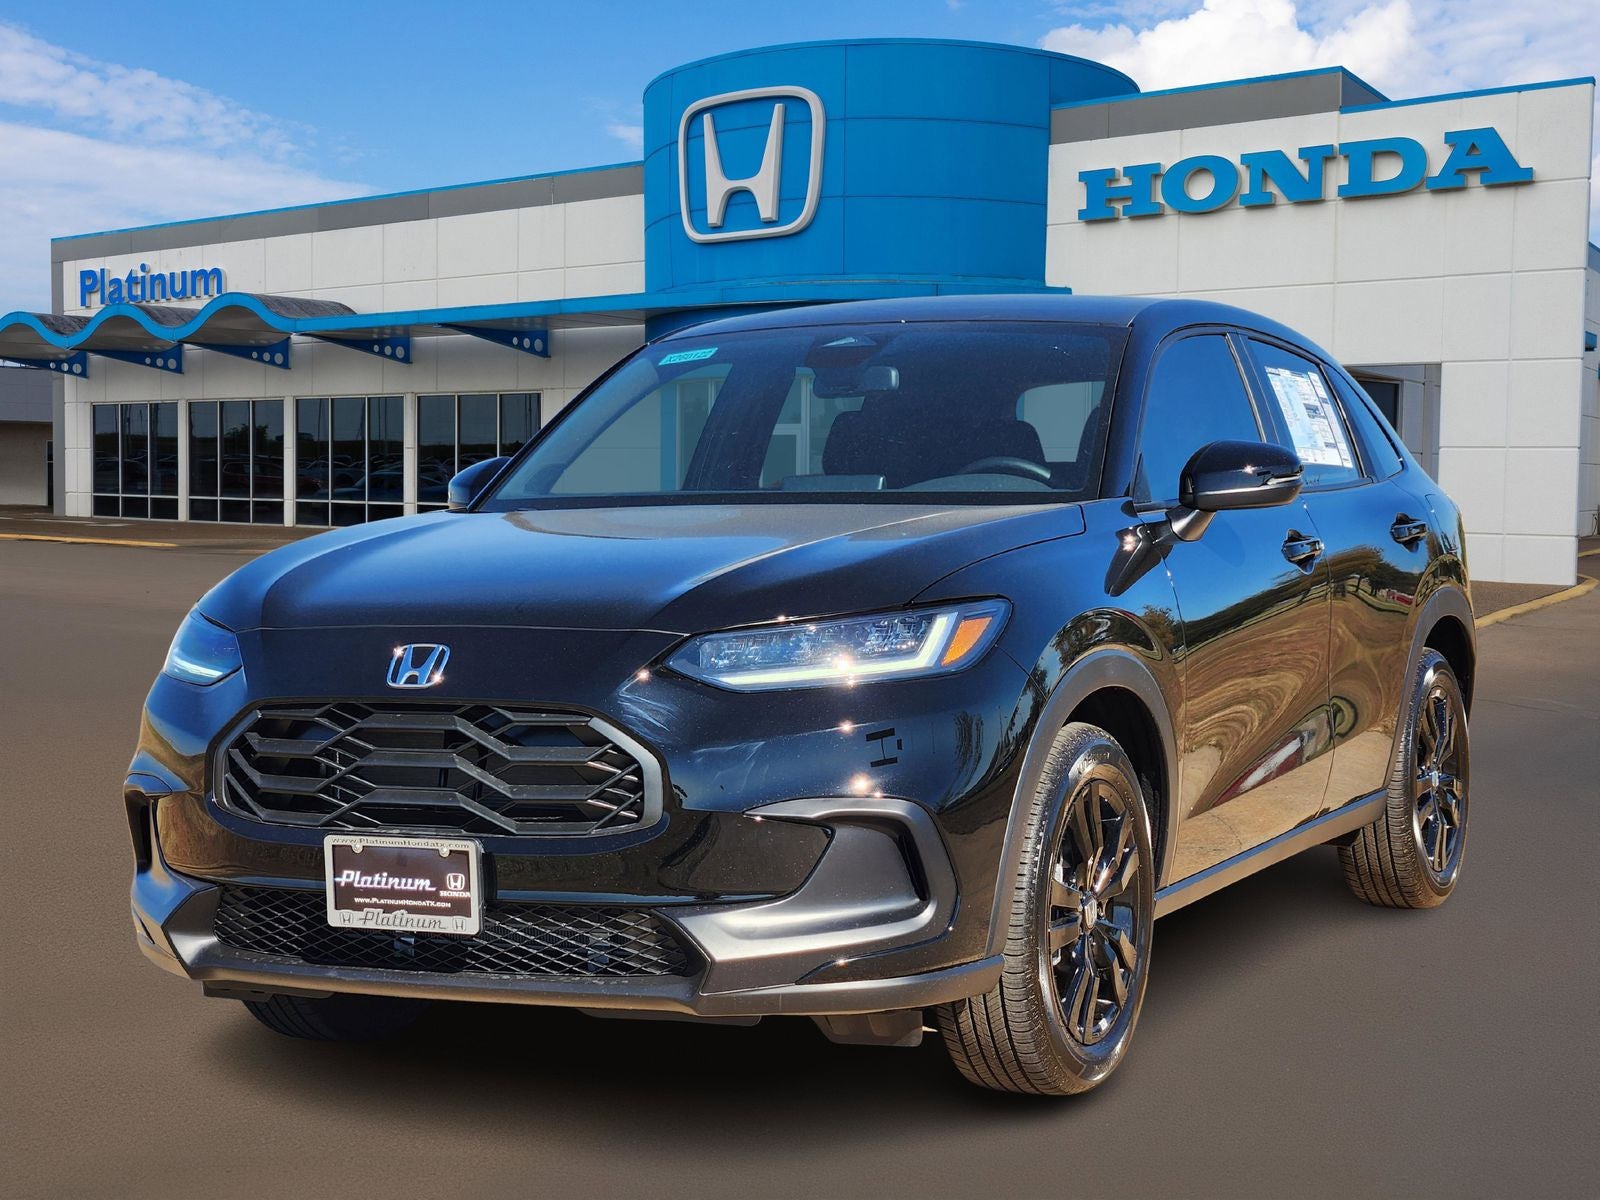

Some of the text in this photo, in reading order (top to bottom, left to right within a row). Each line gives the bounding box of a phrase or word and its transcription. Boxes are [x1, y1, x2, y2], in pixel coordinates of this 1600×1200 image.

[1078, 127, 1533, 221] HONDA
[80, 263, 223, 307] Platinum
[334, 870, 437, 891] Platinum
[440, 890, 471, 898] HONDA
[358, 910, 448, 929] Platinum
